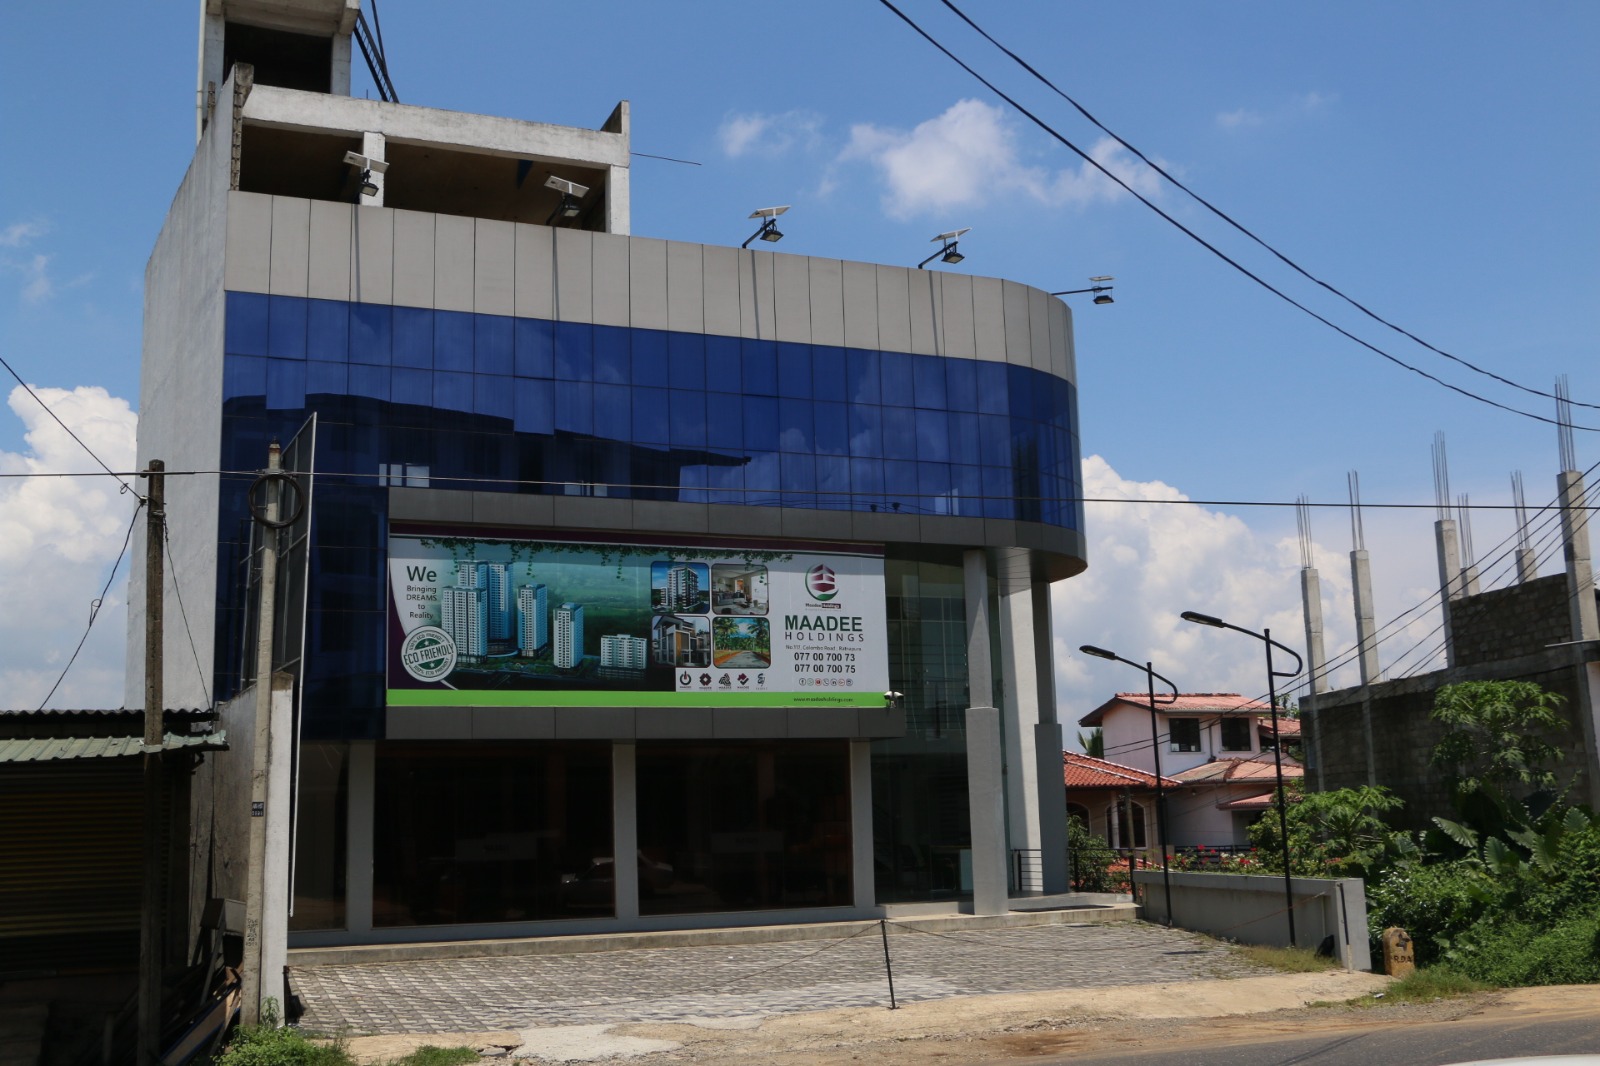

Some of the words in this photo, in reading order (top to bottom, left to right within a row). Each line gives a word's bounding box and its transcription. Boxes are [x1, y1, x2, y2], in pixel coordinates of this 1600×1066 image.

[406, 565, 437, 582] We
[406, 584, 437, 594] Bringing
[409, 611, 434, 619] Reality
[785, 614, 863, 631] MAADEE
[785, 631, 864, 642] HOLDINGS
[403, 651, 420, 666] ECO
[419, 642, 455, 661] FRIENDLY
[794, 652, 810, 661] 077
[812, 652, 824, 661] 00
[826, 653, 842, 662] 700
[844, 653, 856, 662] 73
[794, 663, 810, 672] 077
[813, 664, 824, 673] 00
[826, 664, 843, 673] 700
[845, 664, 856, 673] 75
